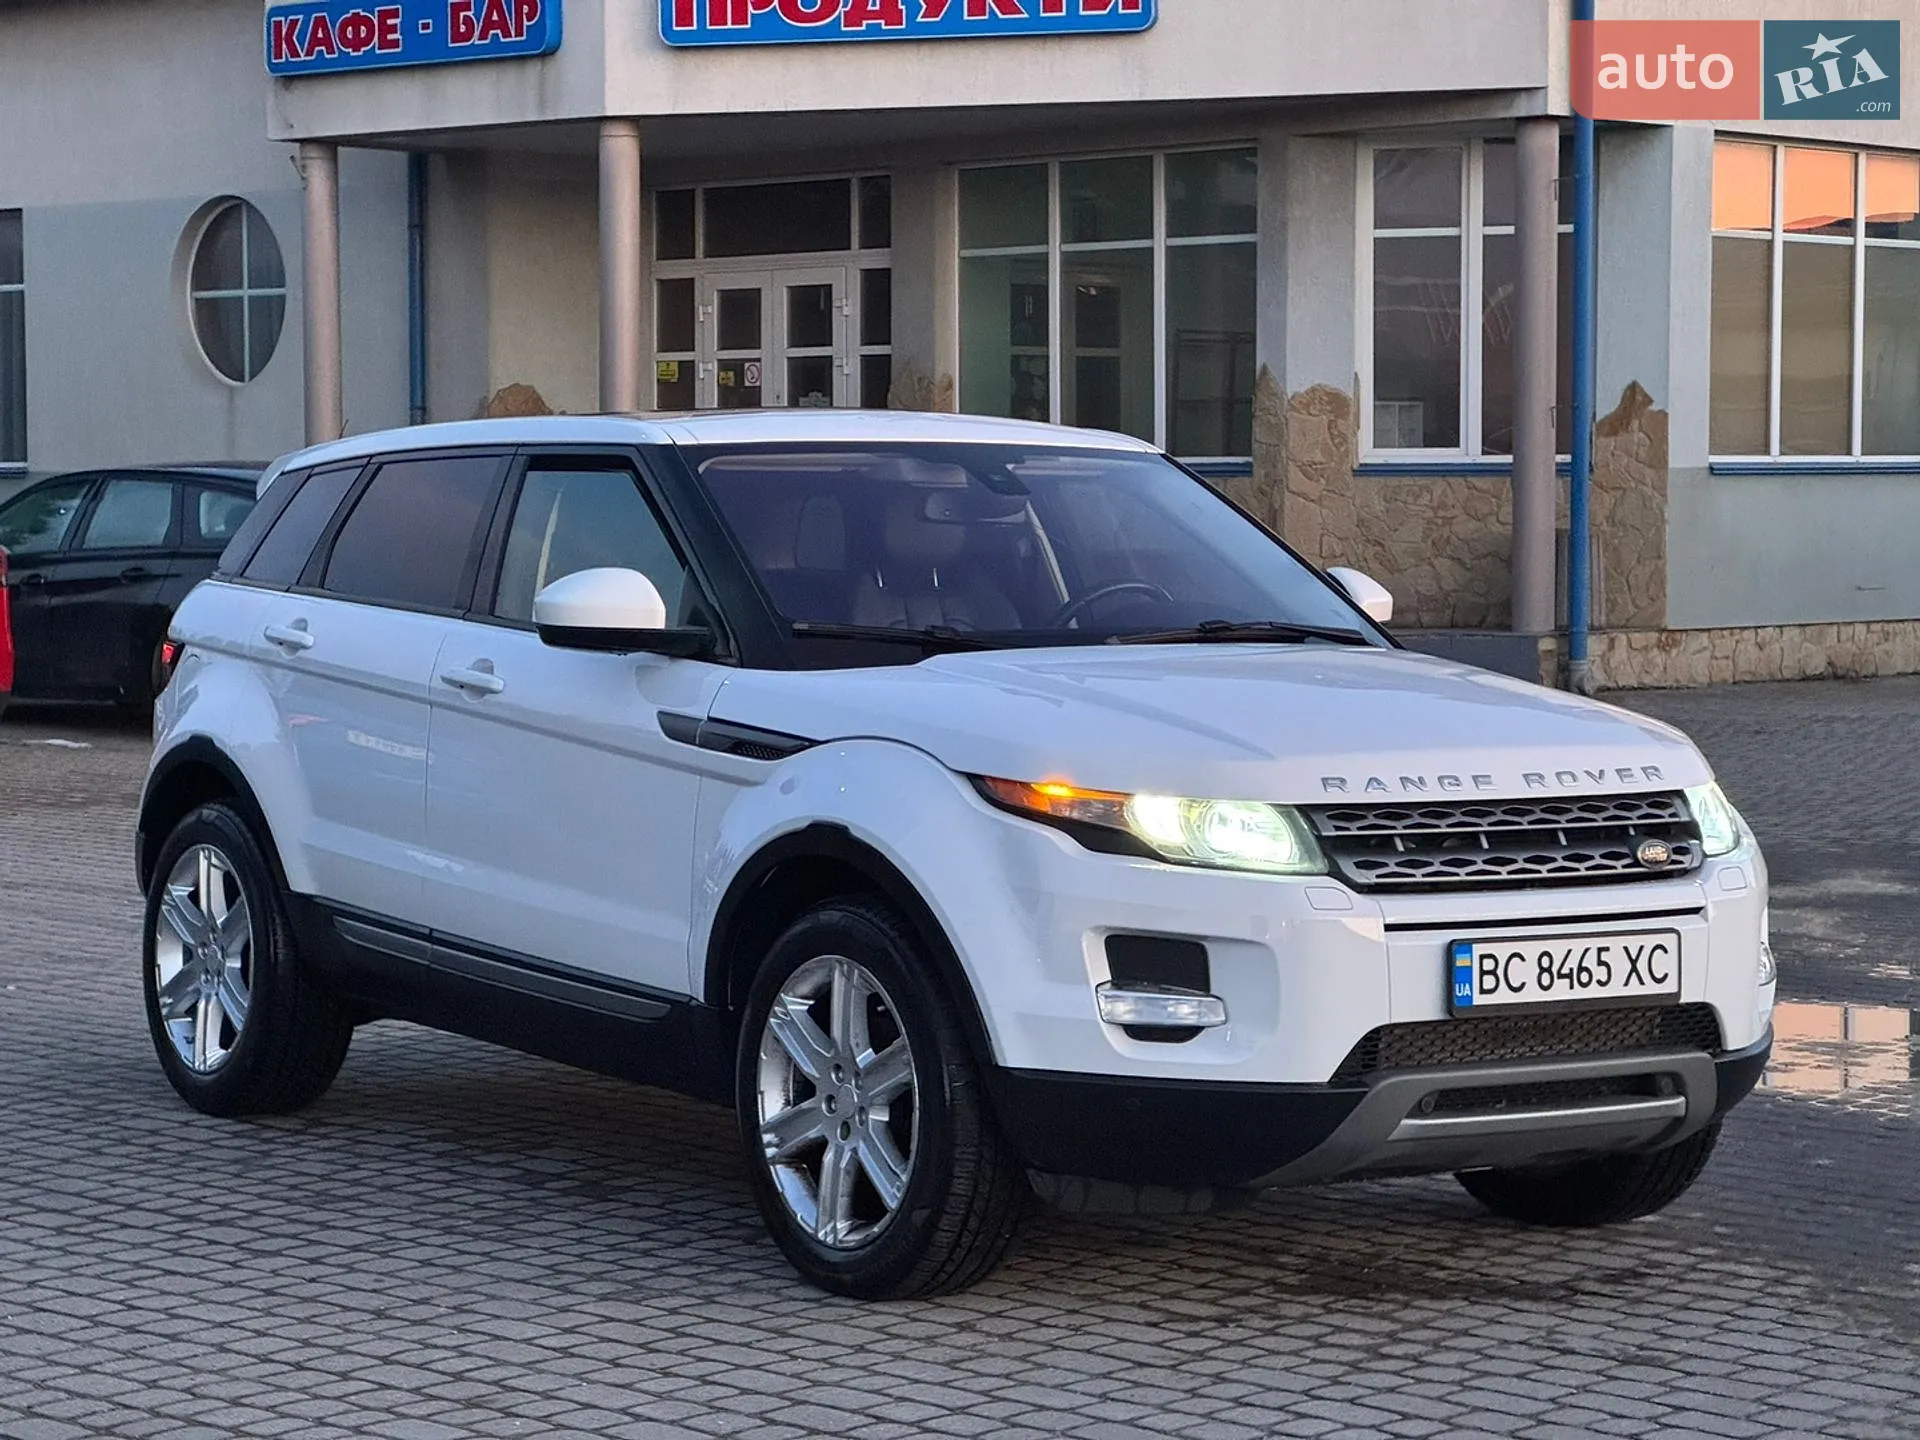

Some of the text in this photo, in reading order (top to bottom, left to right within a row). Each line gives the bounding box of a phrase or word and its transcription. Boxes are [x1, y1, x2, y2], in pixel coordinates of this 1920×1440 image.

[271, 6, 401, 63] КАФЕ
[448, 0, 541, 47] БАР
[1320, 764, 1664, 794] RANGE ROVER
[1478, 943, 1669, 995] BC 8465 XC
[1455, 983, 1472, 997] UA
